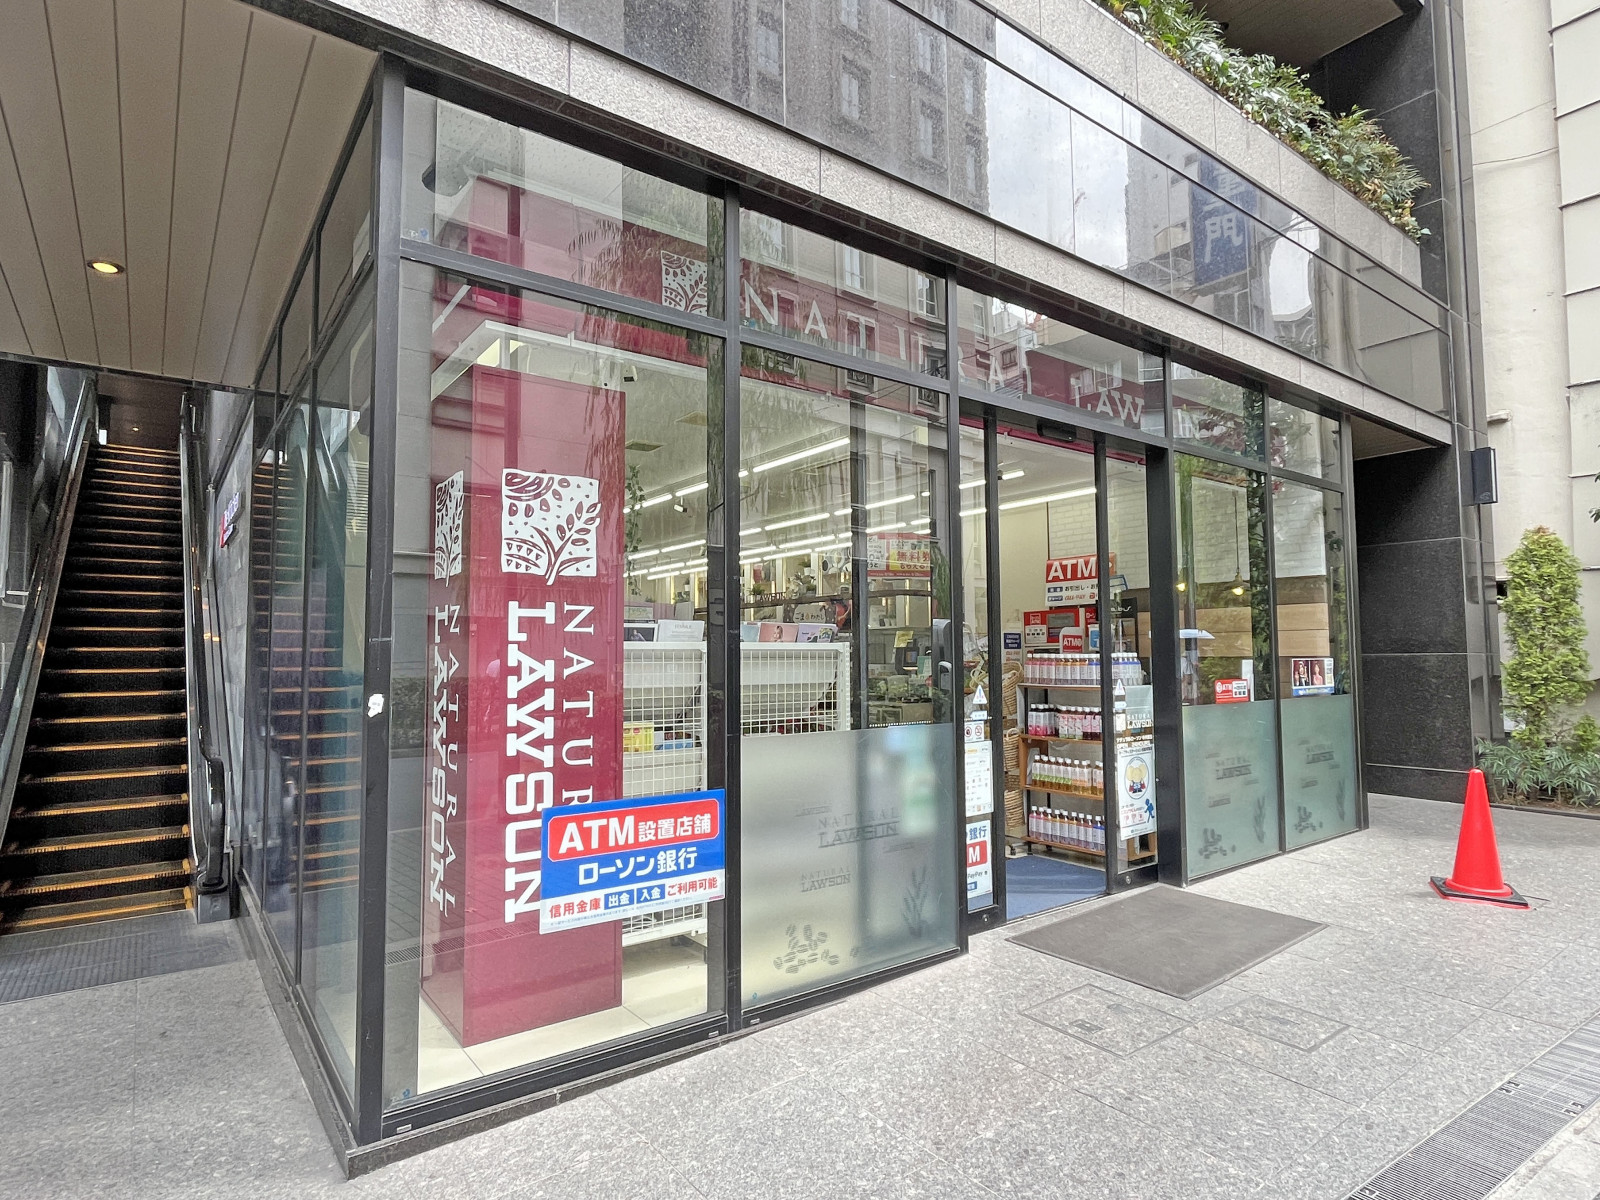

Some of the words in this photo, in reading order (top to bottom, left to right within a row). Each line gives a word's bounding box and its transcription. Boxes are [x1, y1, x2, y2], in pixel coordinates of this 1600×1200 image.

[1047, 557, 1097, 581] ATM
[562, 604, 595, 806] NATUR
[430, 604, 449, 911] LAWSON
[444, 603, 461, 917] NATURAL
[505, 600, 555, 923] LAWSON
[966, 825, 988, 841] 銀行
[578, 846, 698, 886] ローソン銀行
[801, 873, 851, 893] LAWSON
[549, 897, 601, 919] 信用金庫
[607, 891, 630, 908] 出金
[640, 885, 661, 901] 入金
[667, 876, 718, 897] ご利用可能
